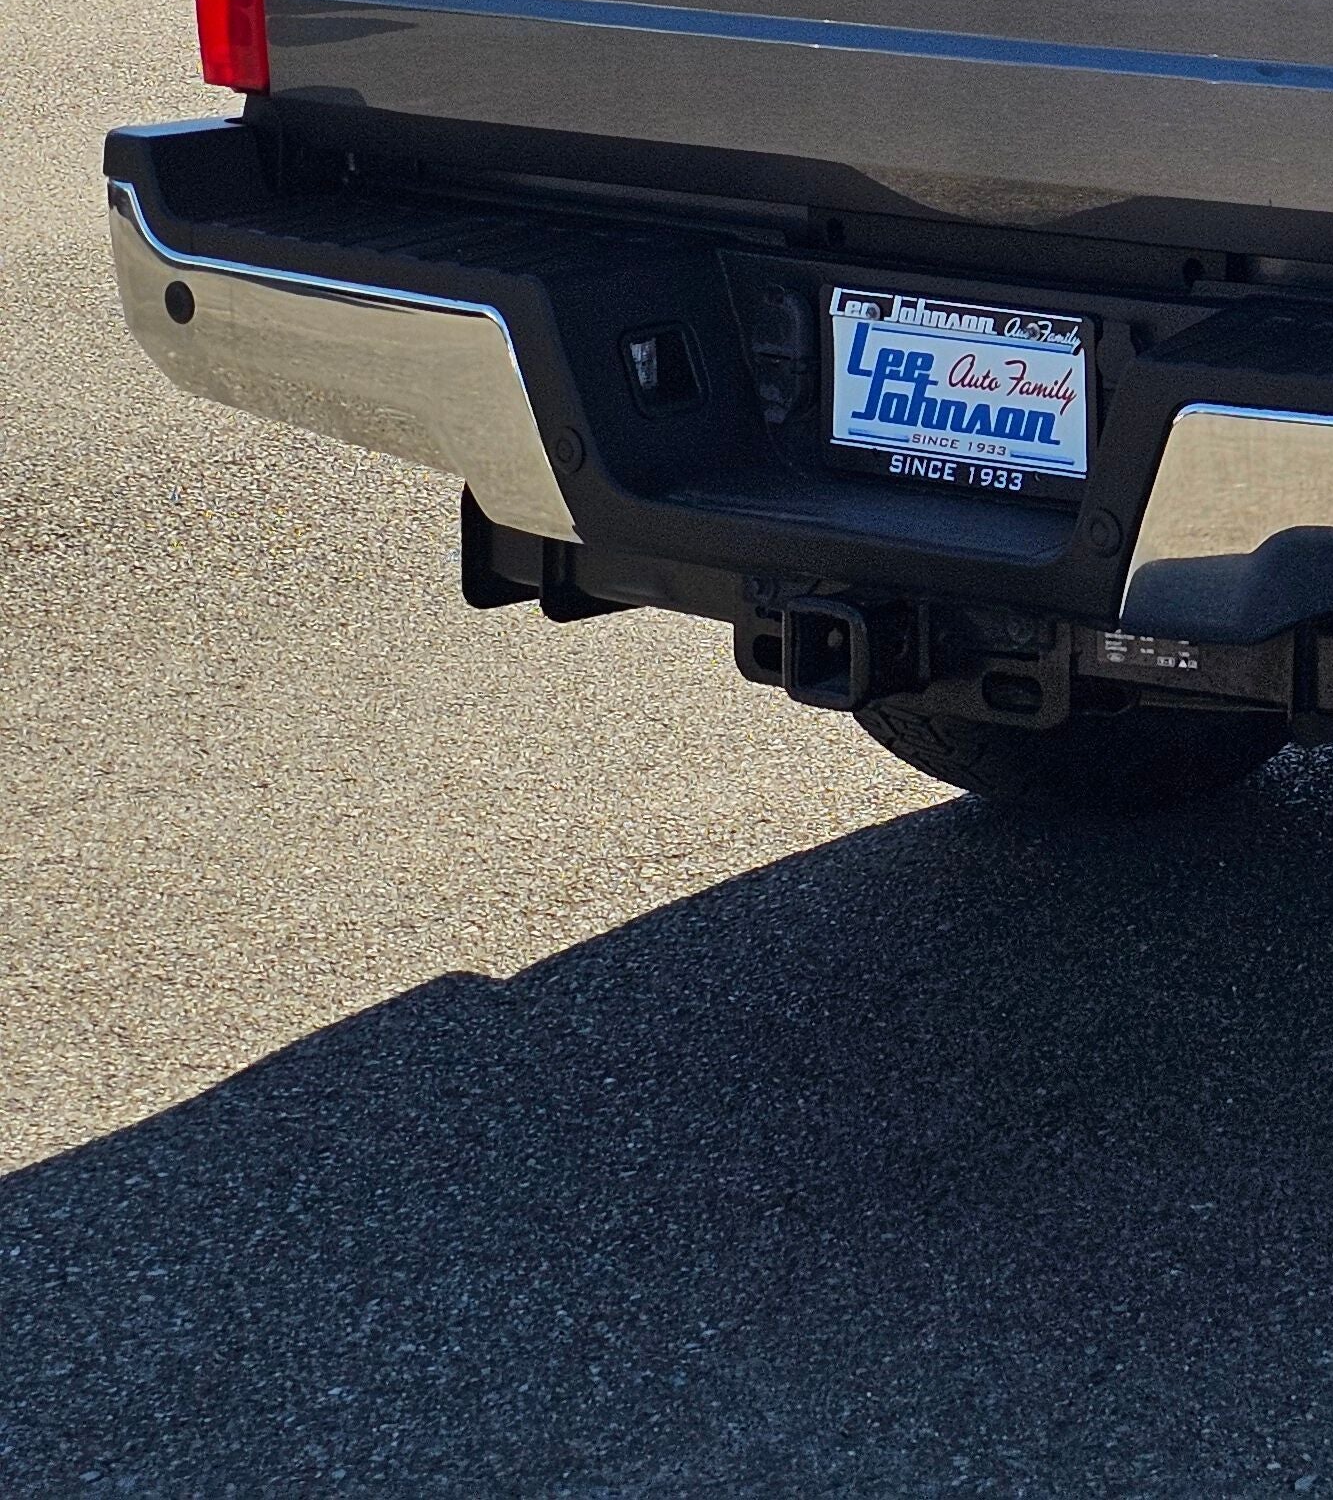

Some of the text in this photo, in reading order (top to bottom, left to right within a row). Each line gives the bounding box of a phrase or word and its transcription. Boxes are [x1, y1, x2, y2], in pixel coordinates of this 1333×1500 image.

[847, 322, 939, 386] Lee
[884, 295, 998, 335] Johnson
[1037, 320, 1082, 354] Family
[851, 370, 1061, 446] Johnson
[949, 353, 1077, 415] Auto Family
[889, 455, 1023, 490] SINCE 1933
[912, 433, 1007, 457] SINCE 1933
